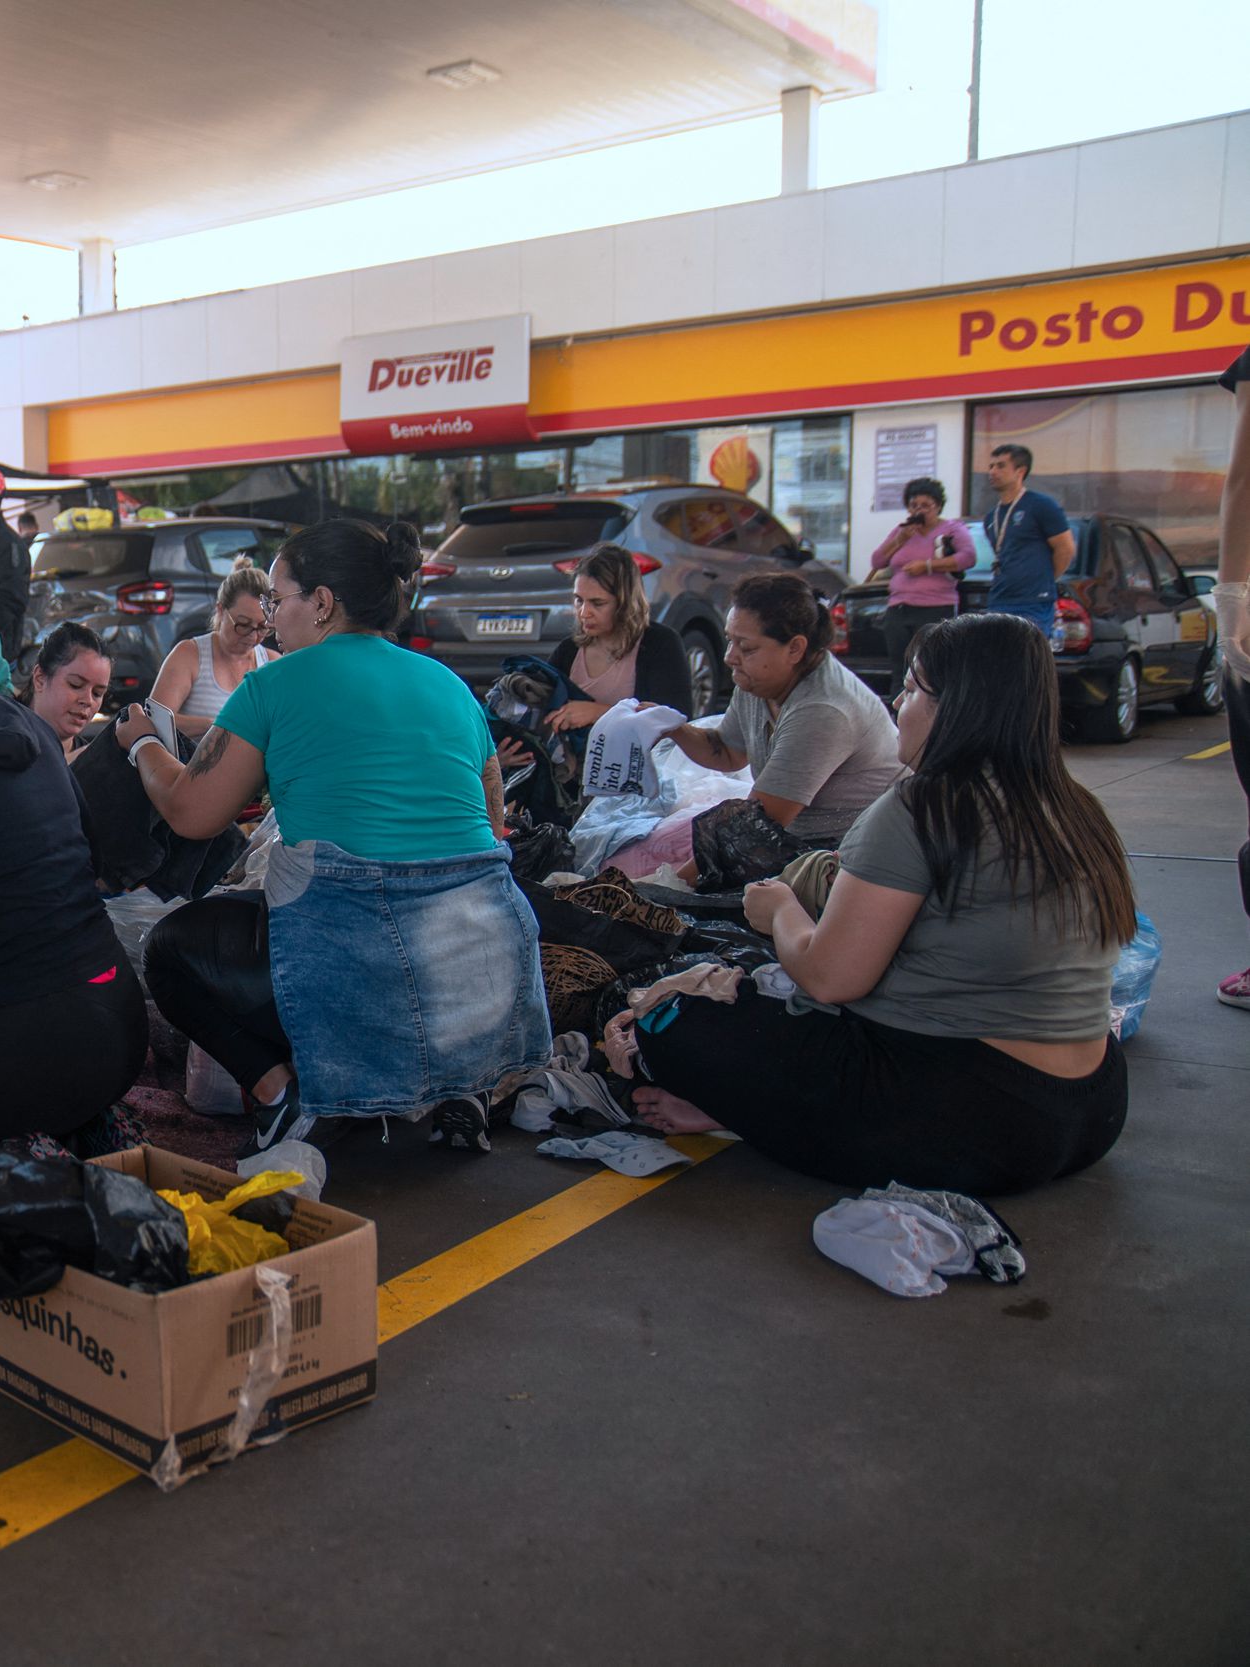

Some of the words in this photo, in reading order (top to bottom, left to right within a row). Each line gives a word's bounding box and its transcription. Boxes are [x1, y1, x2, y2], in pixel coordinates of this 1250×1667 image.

[958, 301, 1144, 357] Posto
[368, 347, 494, 393] Dueville
[389, 416, 474, 439] Bem-vindo
